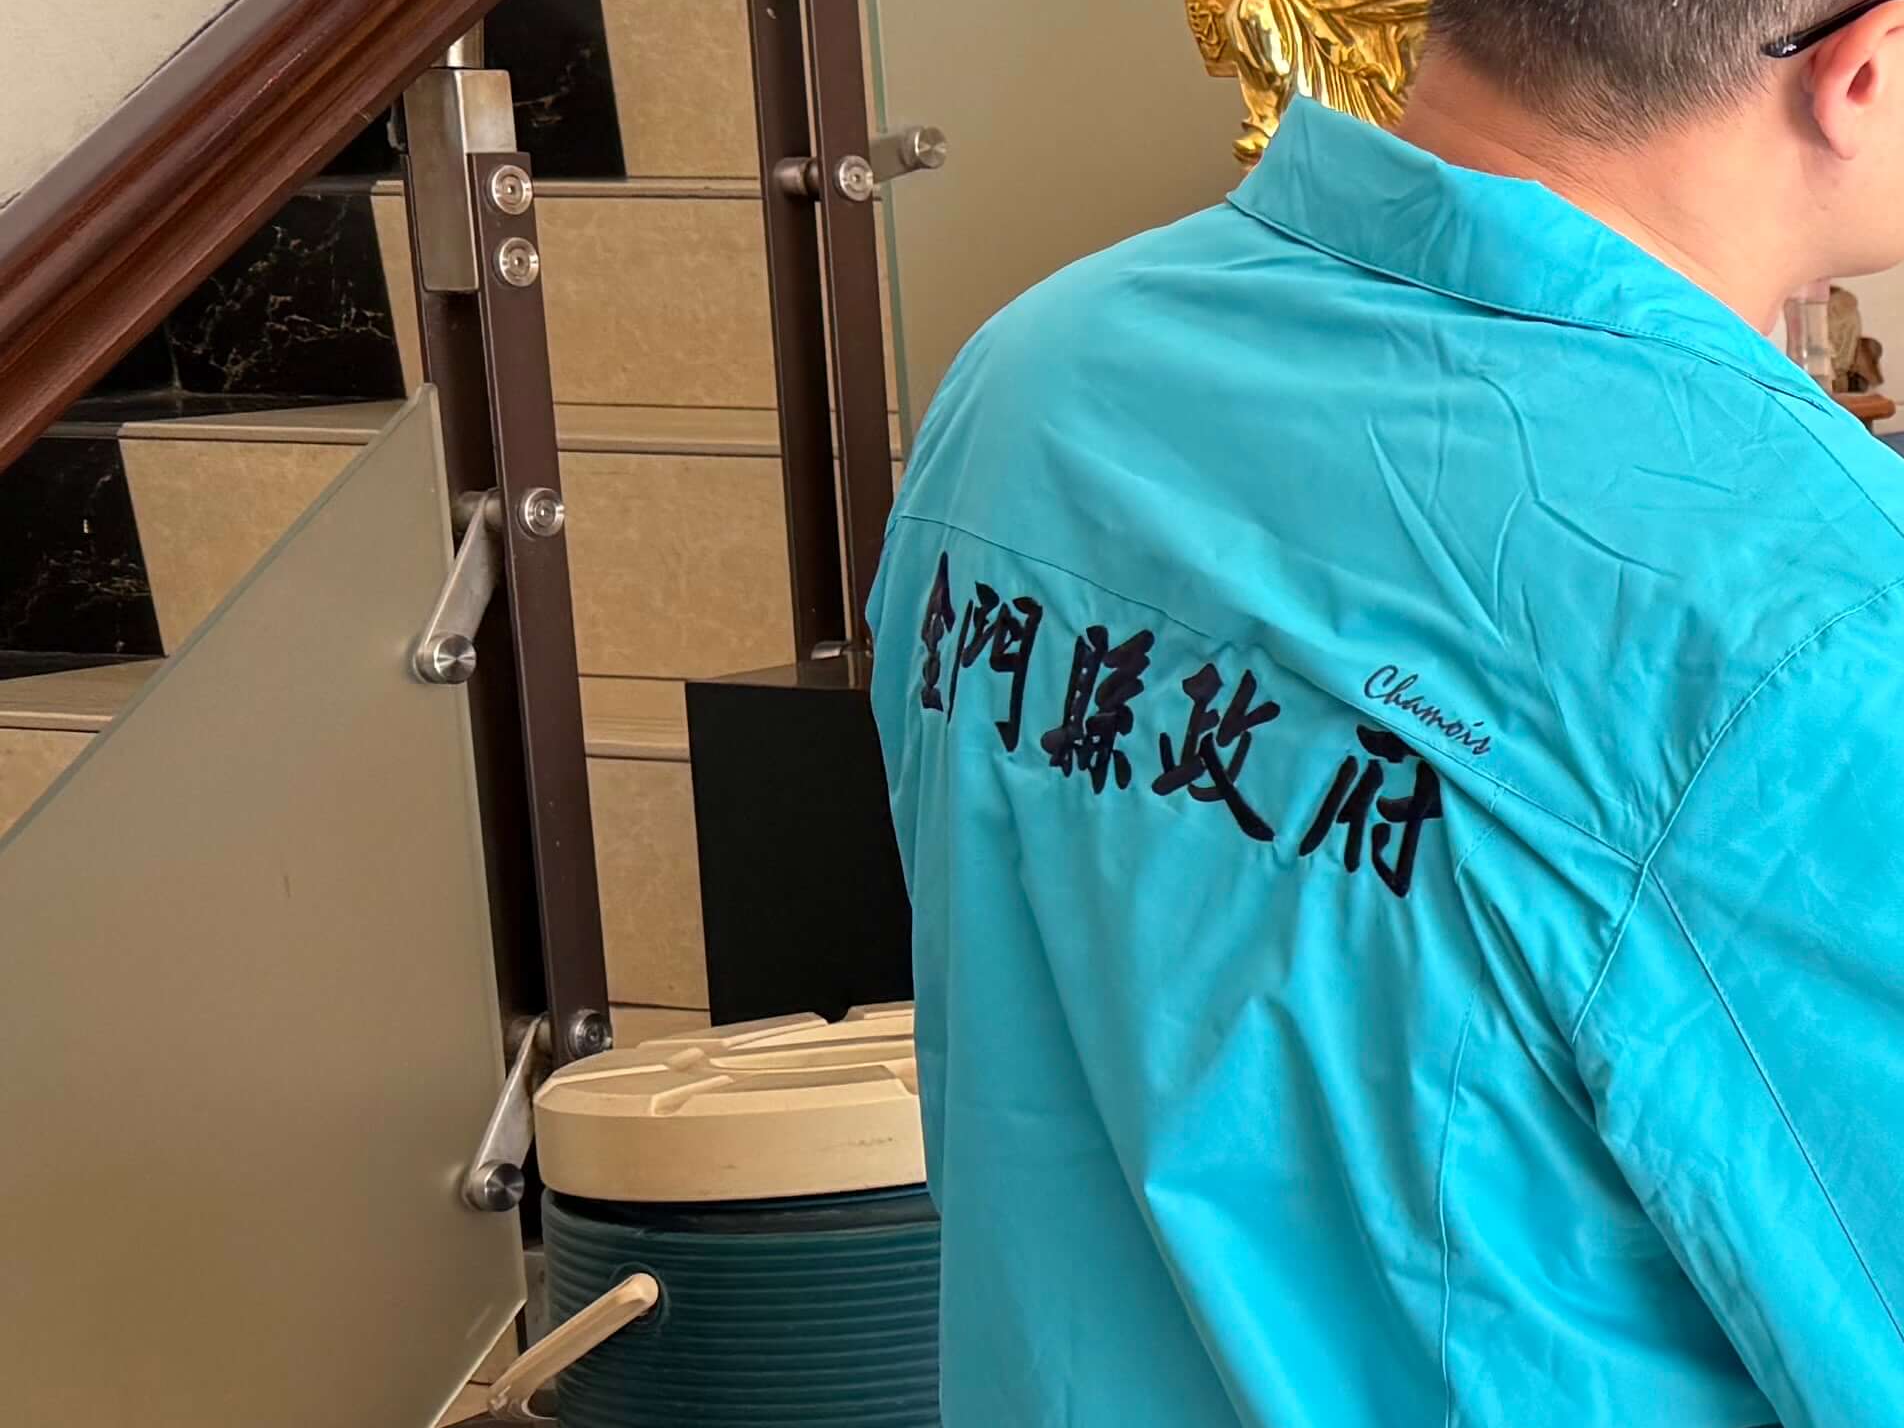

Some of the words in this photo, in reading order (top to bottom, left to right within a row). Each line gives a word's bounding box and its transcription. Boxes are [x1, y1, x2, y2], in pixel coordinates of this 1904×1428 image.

[920, 550, 1442, 899] 金門縣政府
[1363, 664, 1492, 756] Chamois
